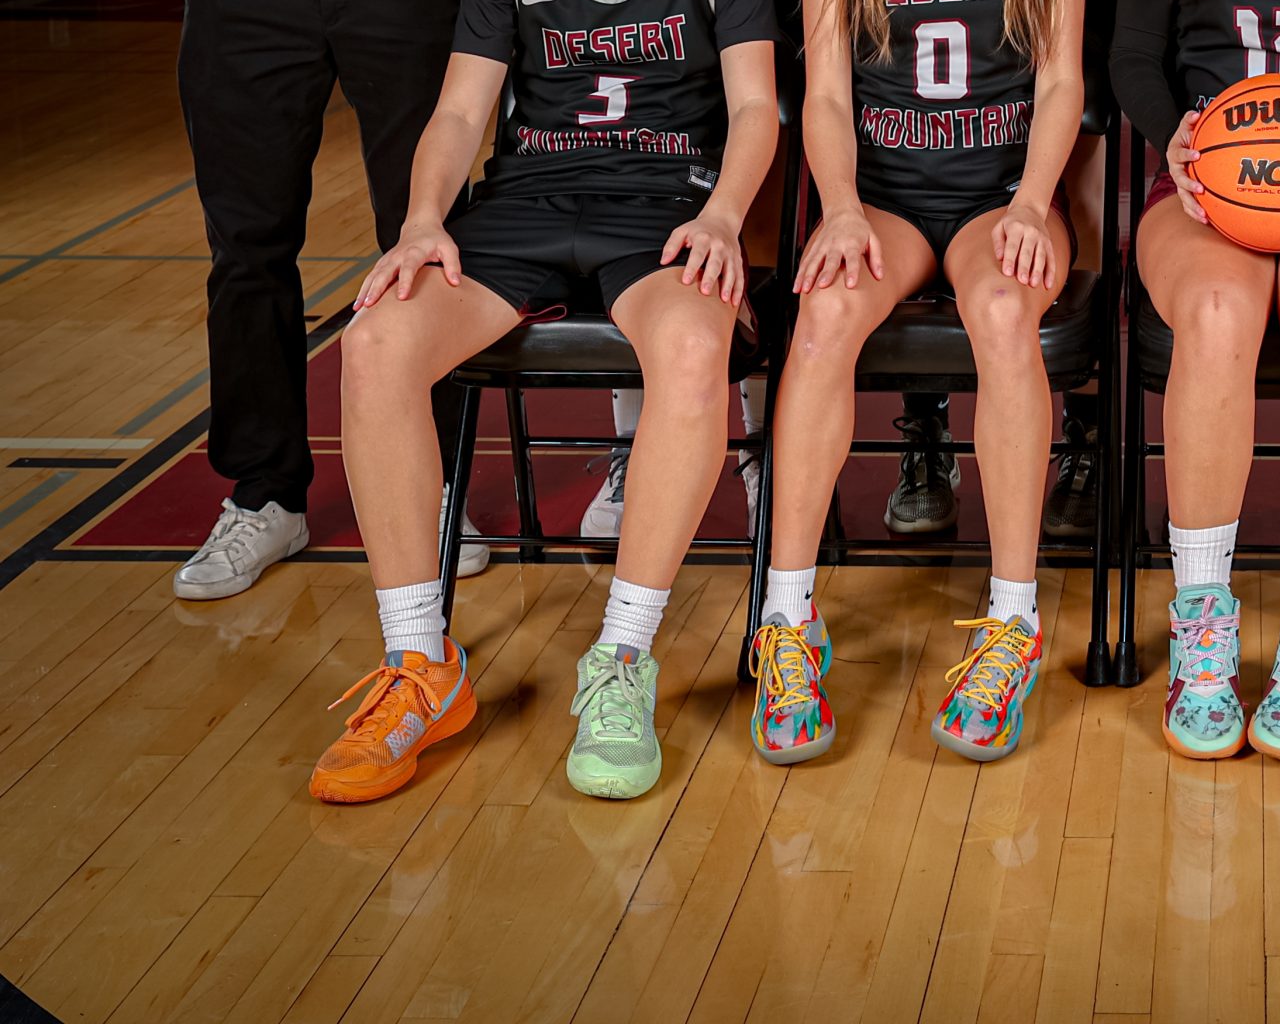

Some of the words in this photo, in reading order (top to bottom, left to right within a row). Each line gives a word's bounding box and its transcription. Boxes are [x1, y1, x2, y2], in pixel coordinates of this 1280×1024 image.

[541, 13, 686, 69] DESERT
[912, 18, 972, 100] 0
[861, 100, 1034, 150] MOUNTAIN
